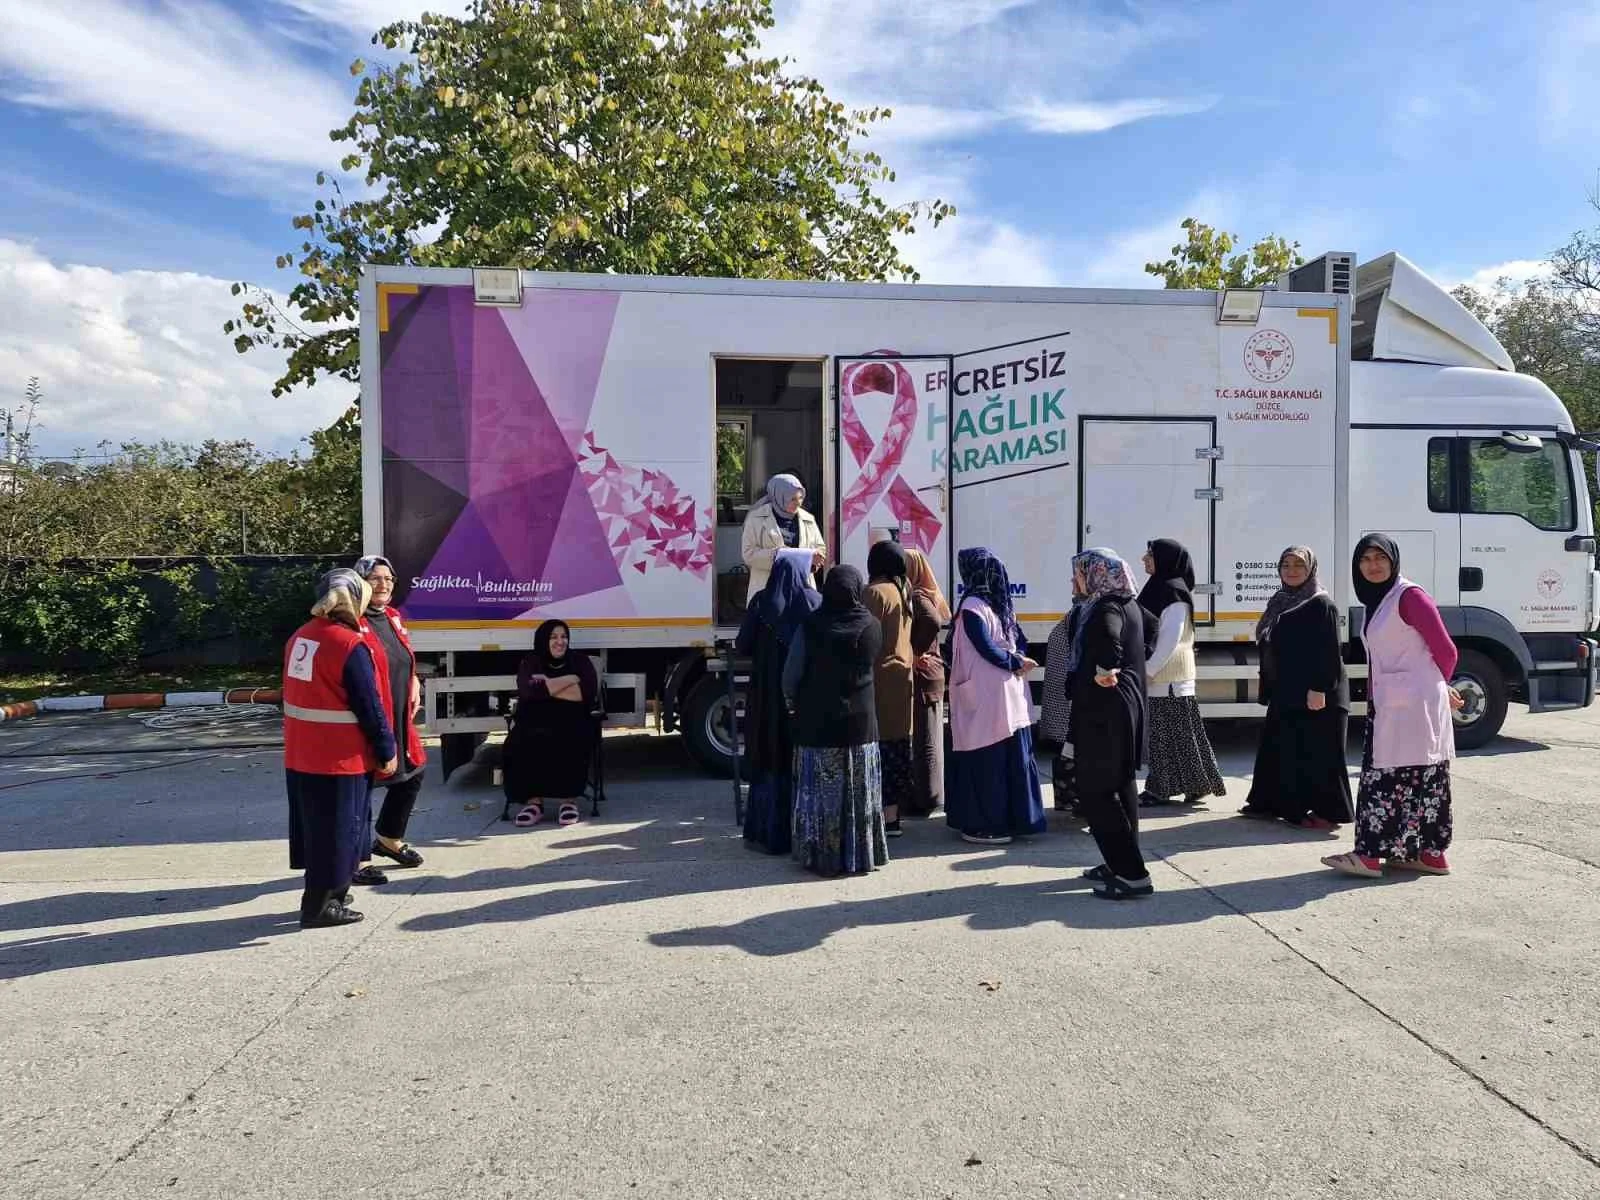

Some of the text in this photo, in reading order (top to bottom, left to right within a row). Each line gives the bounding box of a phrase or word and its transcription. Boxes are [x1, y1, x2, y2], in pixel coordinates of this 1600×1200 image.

[953, 349, 1066, 396] CRETSİZ
[1234, 388, 1267, 399] SAĞLIK
[1270, 389, 1322, 399] BAKANLIĞI
[953, 388, 1066, 442] AĞLIK
[952, 429, 1066, 472] ARAMASI
[411, 575, 553, 595] Sağlıkta Buluşalım
